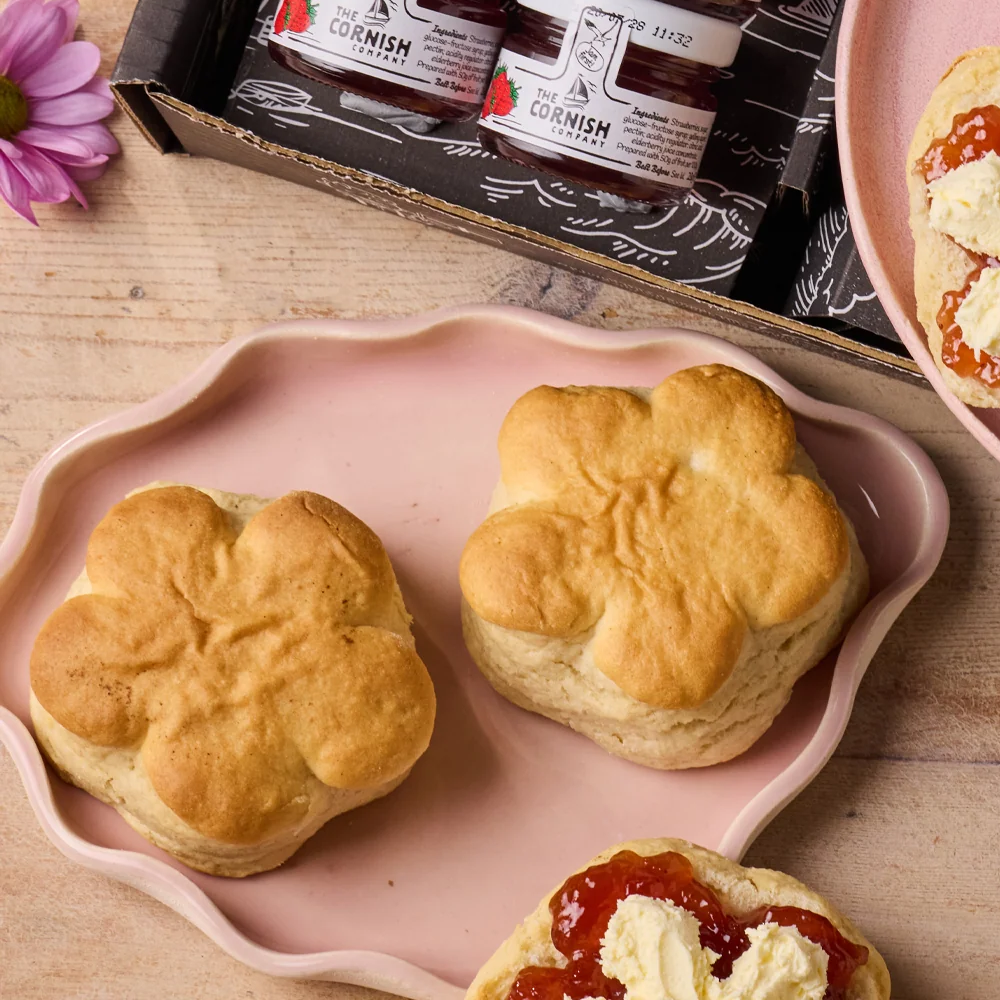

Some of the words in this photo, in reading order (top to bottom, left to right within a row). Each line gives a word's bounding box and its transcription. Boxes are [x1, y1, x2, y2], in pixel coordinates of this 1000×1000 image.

[336, 5, 359, 21] THE
[329, 17, 412, 58] CORNISH
[652, 26, 693, 48] 11:32
[352, 43, 406, 66] COMPANY
[585, 47, 598, 60] Jam
[537, 88, 559, 103] THE
[530, 100, 611, 139] CORNISH
[551, 126, 605, 148] COMPANY
